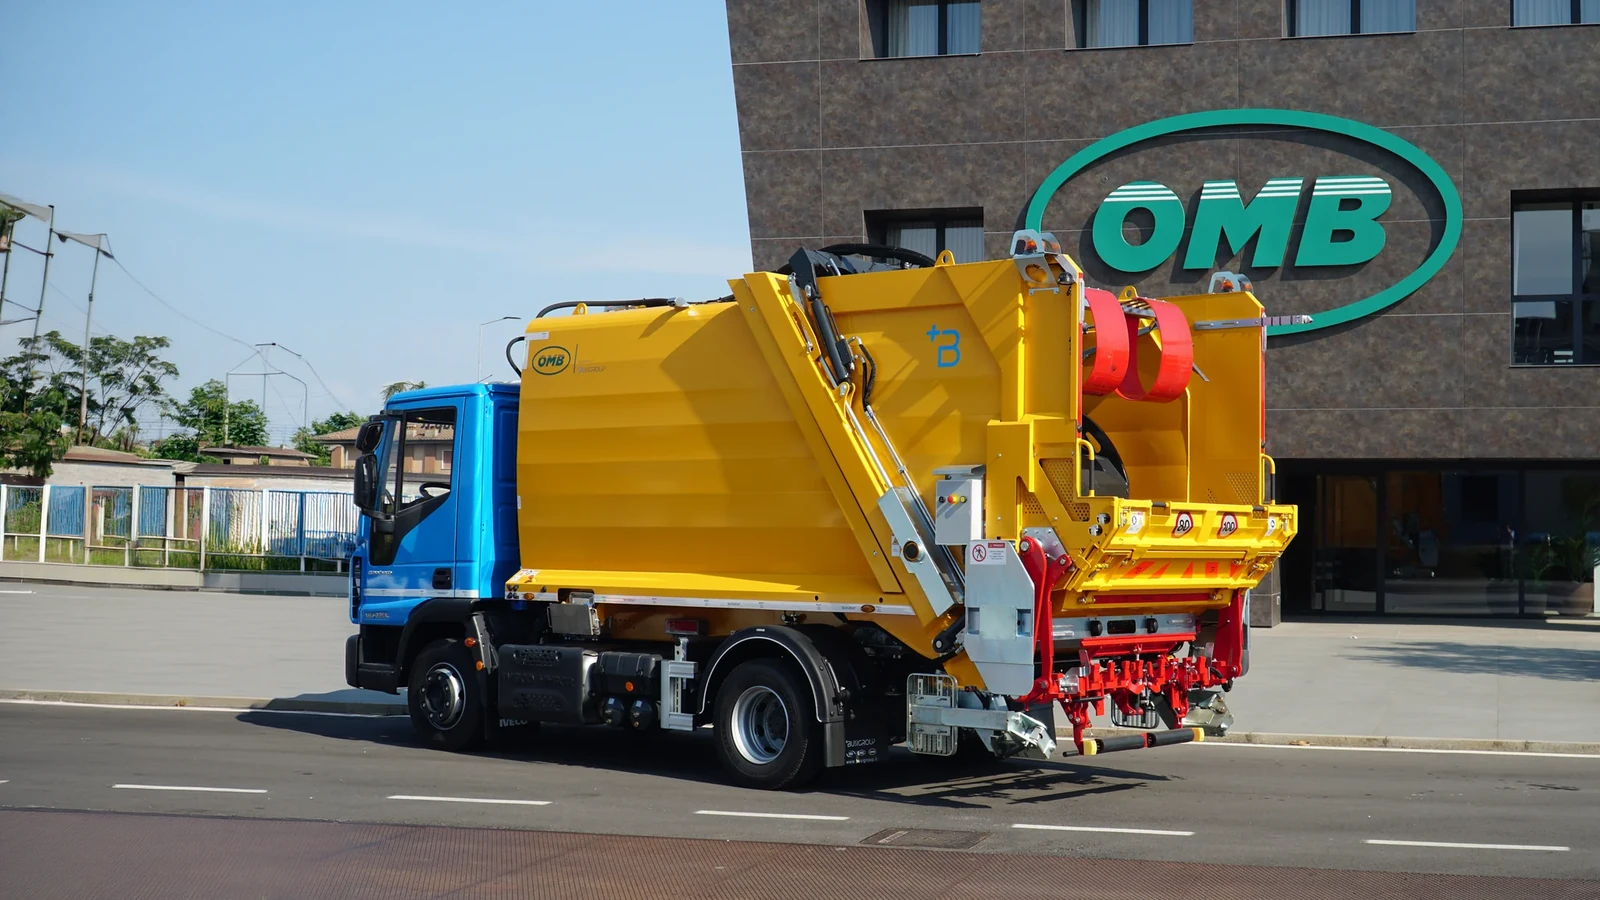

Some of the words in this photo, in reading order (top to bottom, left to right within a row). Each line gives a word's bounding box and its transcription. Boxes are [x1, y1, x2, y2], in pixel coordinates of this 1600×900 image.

[1092, 175, 1392, 272] OMB
[538, 354, 565, 367] OMB
[1177, 519, 1190, 531] 80
[1222, 521, 1236, 531] 100
[499, 718, 528, 727] IVECO
